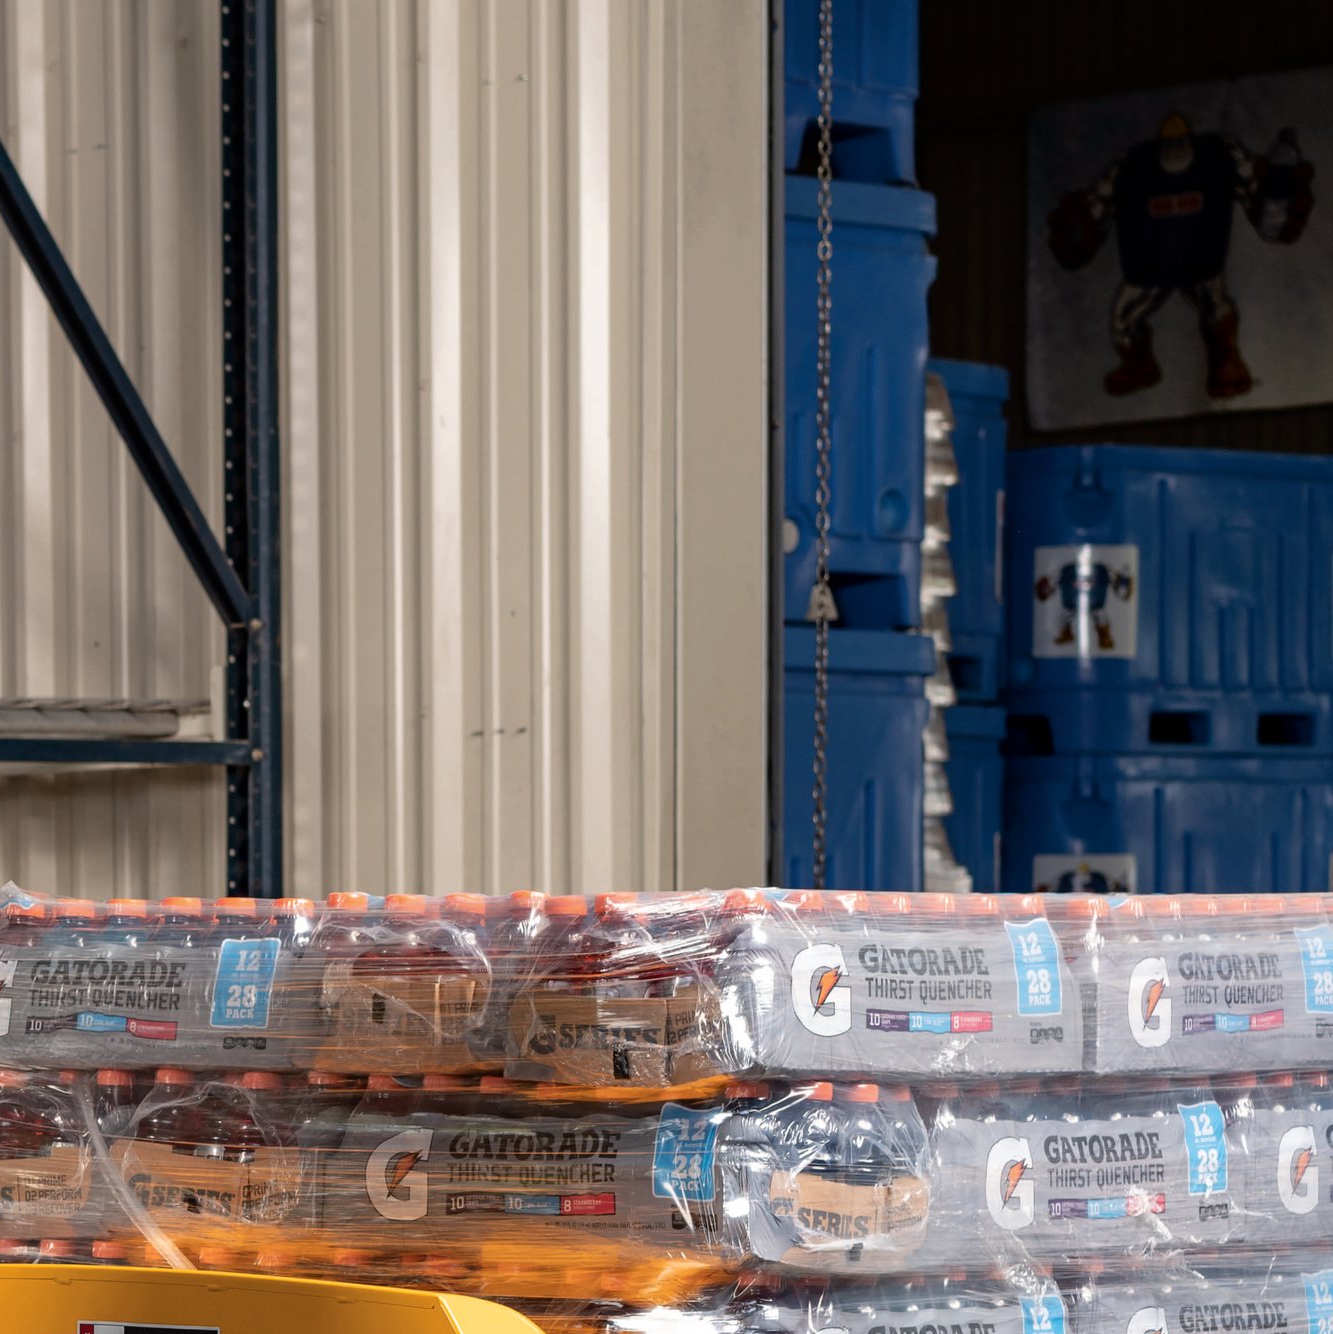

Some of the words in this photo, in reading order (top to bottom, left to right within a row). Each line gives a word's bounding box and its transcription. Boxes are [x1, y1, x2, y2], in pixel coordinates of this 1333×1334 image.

[1018, 933, 1041, 956] 12
[1306, 938, 1326, 958] 12
[32, 959, 186, 987] GATORADE
[235, 951, 261, 971] 12
[858, 945, 989, 977] GATORADE
[1178, 952, 1283, 981] GATORADE
[791, 943, 852, 1037] G
[866, 977, 914, 1000] THIRST
[919, 980, 992, 1005] QUENCHER
[1027, 969, 1051, 993] 28
[1314, 972, 1333, 994] 28
[29, 989, 83, 1007] THIRST
[92, 990, 181, 1010] QUENCHER
[226, 985, 257, 1008] 28
[1028, 995, 1051, 1005] PACK
[1128, 957, 1172, 1048] G
[1183, 986, 1219, 1004] THIRST
[1224, 984, 1283, 1008] QUENCHER
[29, 1019, 42, 1031] 10
[226, 1009, 254, 1019] PACK
[869, 1013, 880, 1026] 10
[912, 1015, 922, 1028] 10
[953, 1015, 960, 1029] 8
[130, 1021, 137, 1032] 8
[676, 1118, 706, 1141] 12
[1190, 1113, 1213, 1137] 12
[449, 1129, 621, 1160] GATORADE
[1043, 1132, 1163, 1164] GATORADE
[671, 1154, 702, 1179] 28
[1198, 1149, 1218, 1173] 28
[1277, 1125, 1319, 1215] G
[365, 1128, 434, 1221] G
[448, 1163, 512, 1183] THIRST
[519, 1164, 615, 1187] QUENCHER
[672, 1180, 700, 1190] PACK
[986, 1136, 1034, 1230] G
[1047, 1168, 1093, 1188] THIRST
[1097, 1164, 1165, 1191] QUENCHER
[450, 1197, 464, 1211] 10
[508, 1197, 522, 1210] 10
[564, 1200, 571, 1212] 8
[1050, 1202, 1062, 1216] 10
[1089, 1202, 1100, 1216] 10
[1312, 1281, 1333, 1305] 12
[1031, 1306, 1051, 1331] 12
[1179, 1302, 1288, 1333] GATORADE
